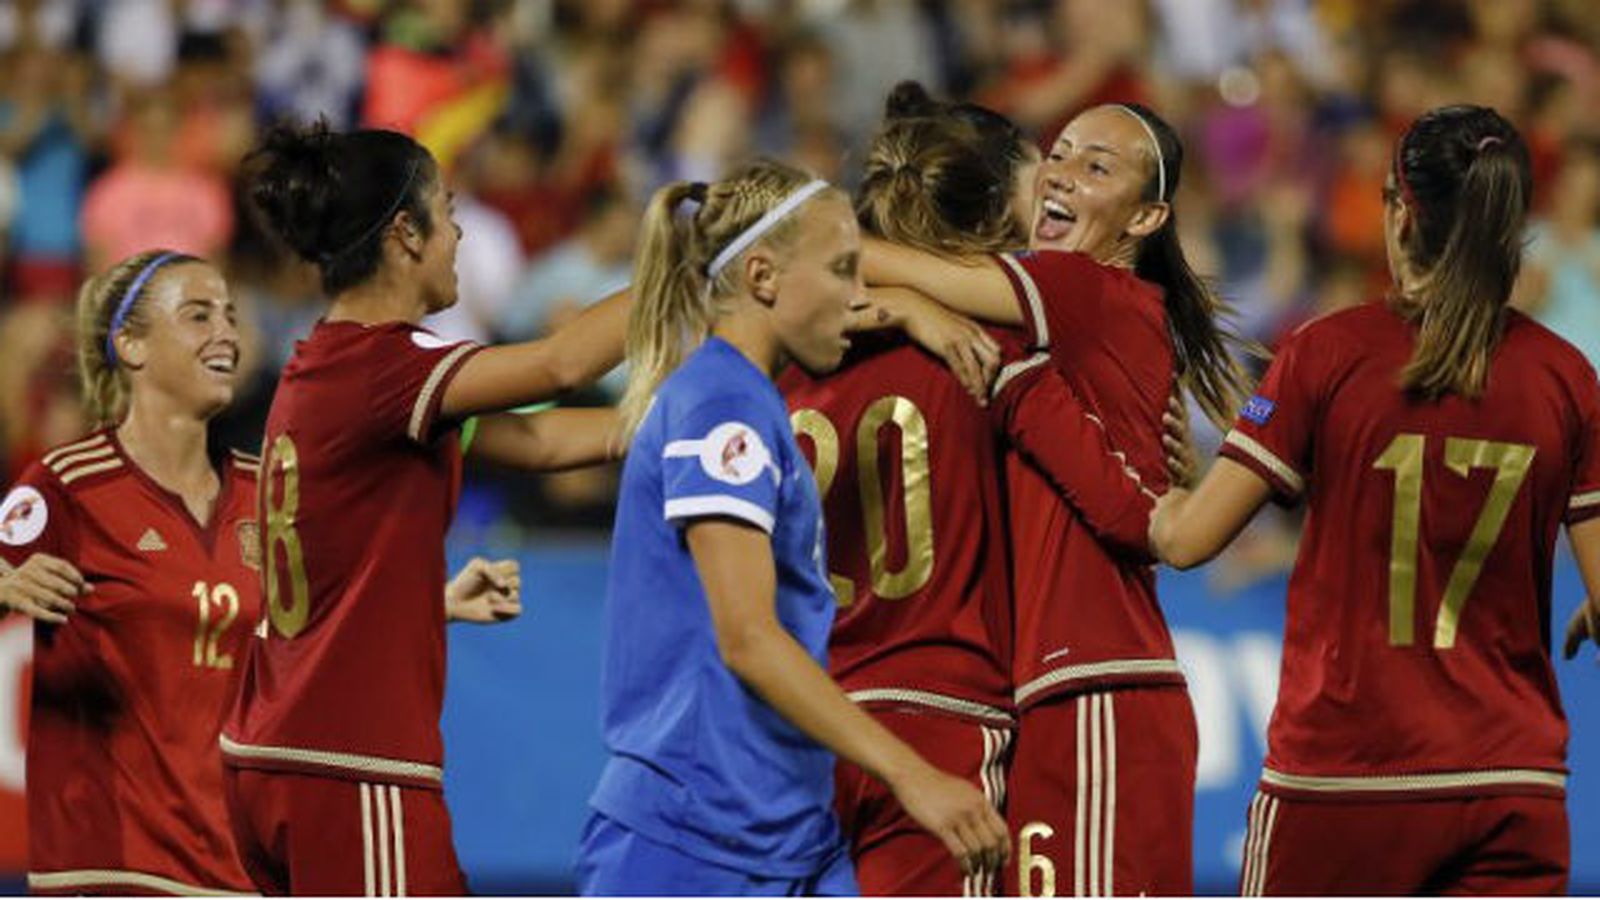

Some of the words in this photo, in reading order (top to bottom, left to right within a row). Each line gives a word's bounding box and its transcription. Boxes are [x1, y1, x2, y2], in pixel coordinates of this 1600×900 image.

[257, 434, 309, 638] 8
[1373, 434, 1537, 649] 17
[192, 580, 239, 669] 12
[1019, 822, 1056, 897] 6
